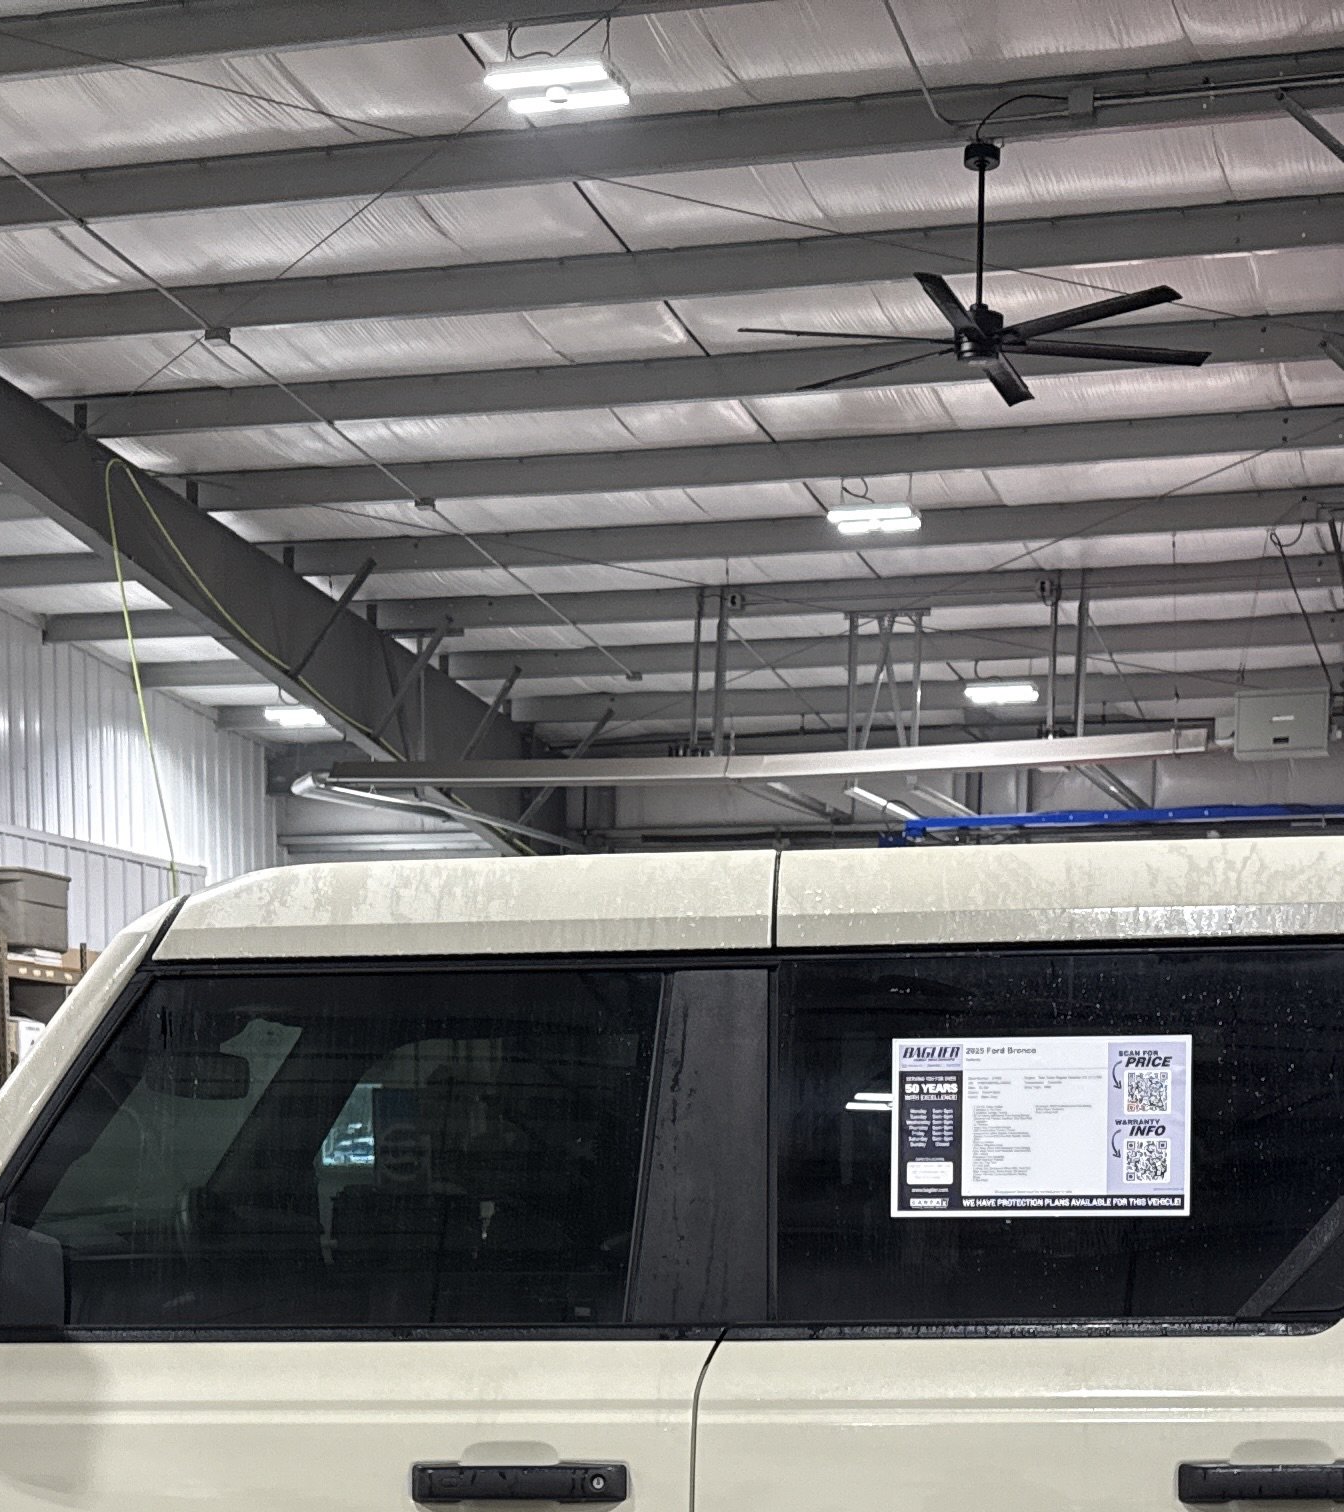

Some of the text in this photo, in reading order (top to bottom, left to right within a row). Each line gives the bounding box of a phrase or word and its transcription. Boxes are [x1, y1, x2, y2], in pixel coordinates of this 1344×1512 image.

[1125, 1056, 1173, 1068] PRICE
[904, 1083, 920, 1093] 50
[920, 1083, 958, 1093] YEARS
[1129, 1125, 1166, 1136] INFO
[962, 1198, 975, 1207] WE
[976, 1198, 996, 1207] HAVE
[997, 1198, 1043, 1207] PROTECTION
[1044, 1198, 1070, 1207] PLANS
[1071, 1198, 1112, 1207] AVAILABLE
[1113, 1198, 1128, 1207] FOR
[1129, 1198, 1146, 1207] THIS
